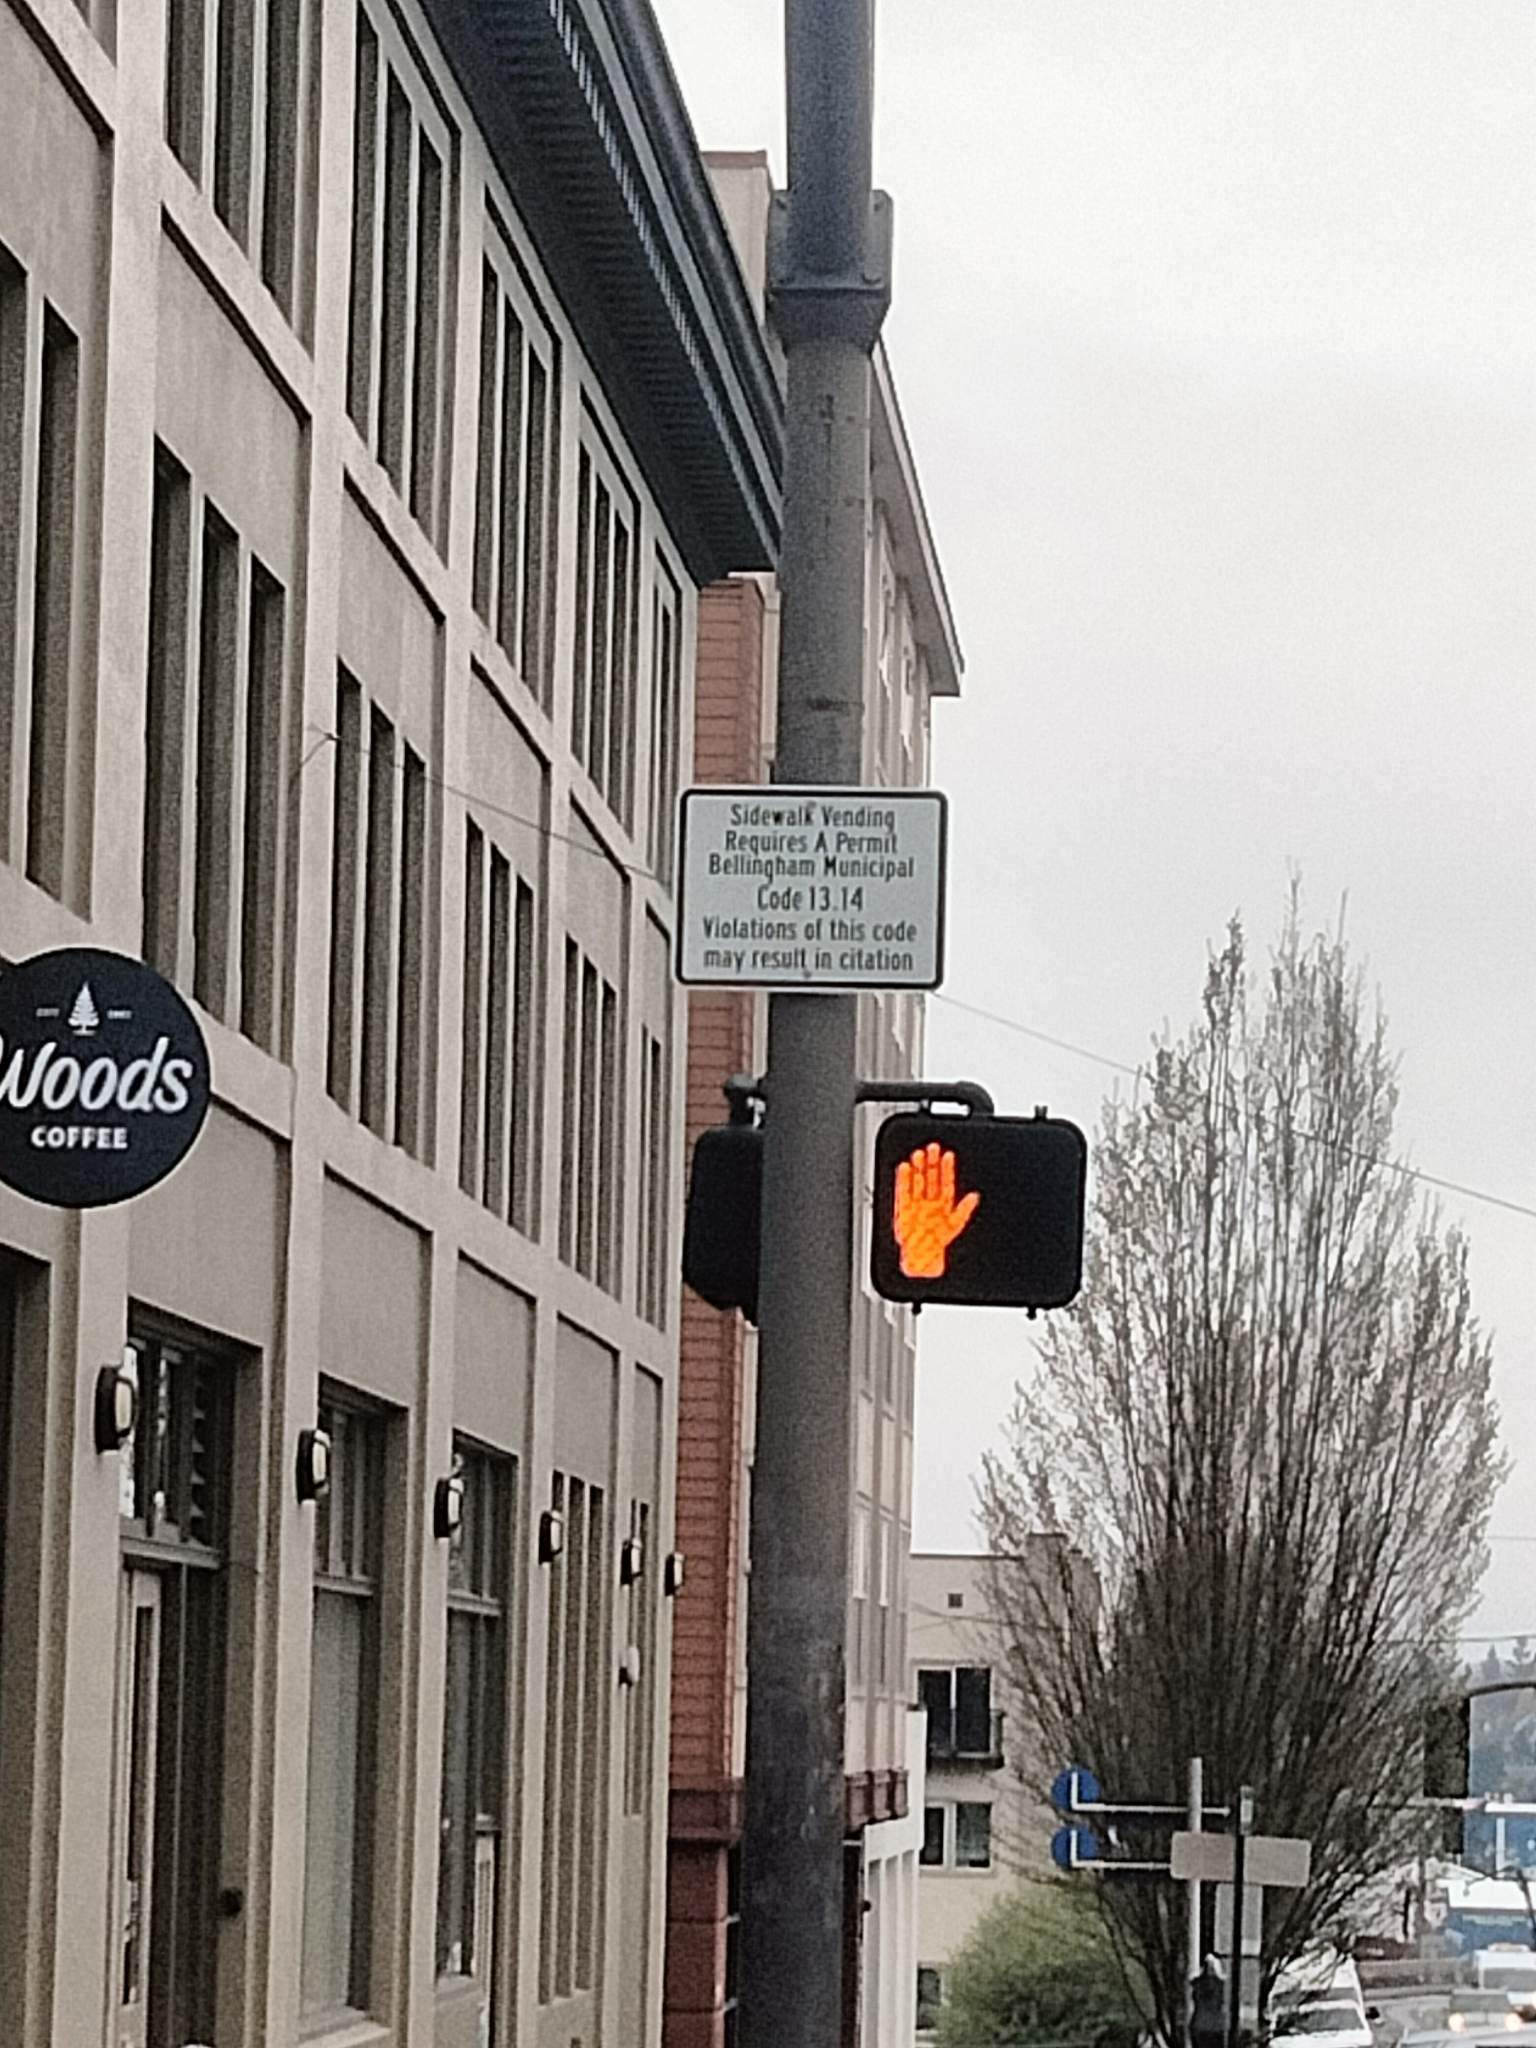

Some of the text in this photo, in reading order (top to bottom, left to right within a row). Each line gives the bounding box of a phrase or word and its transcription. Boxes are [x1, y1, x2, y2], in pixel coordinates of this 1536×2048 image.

[730, 803, 895, 834] Sidewalk Vending
[725, 830, 897, 855] Requires A Permit
[708, 854, 914, 884] Bellingham Municipal
[757, 885, 863, 912] Code 13.14
[703, 916, 917, 942] Violations of this code
[703, 948, 914, 974] may result in citation
[0, 1035, 193, 1113] Woods
[30, 1125, 128, 1149] COFFEE
